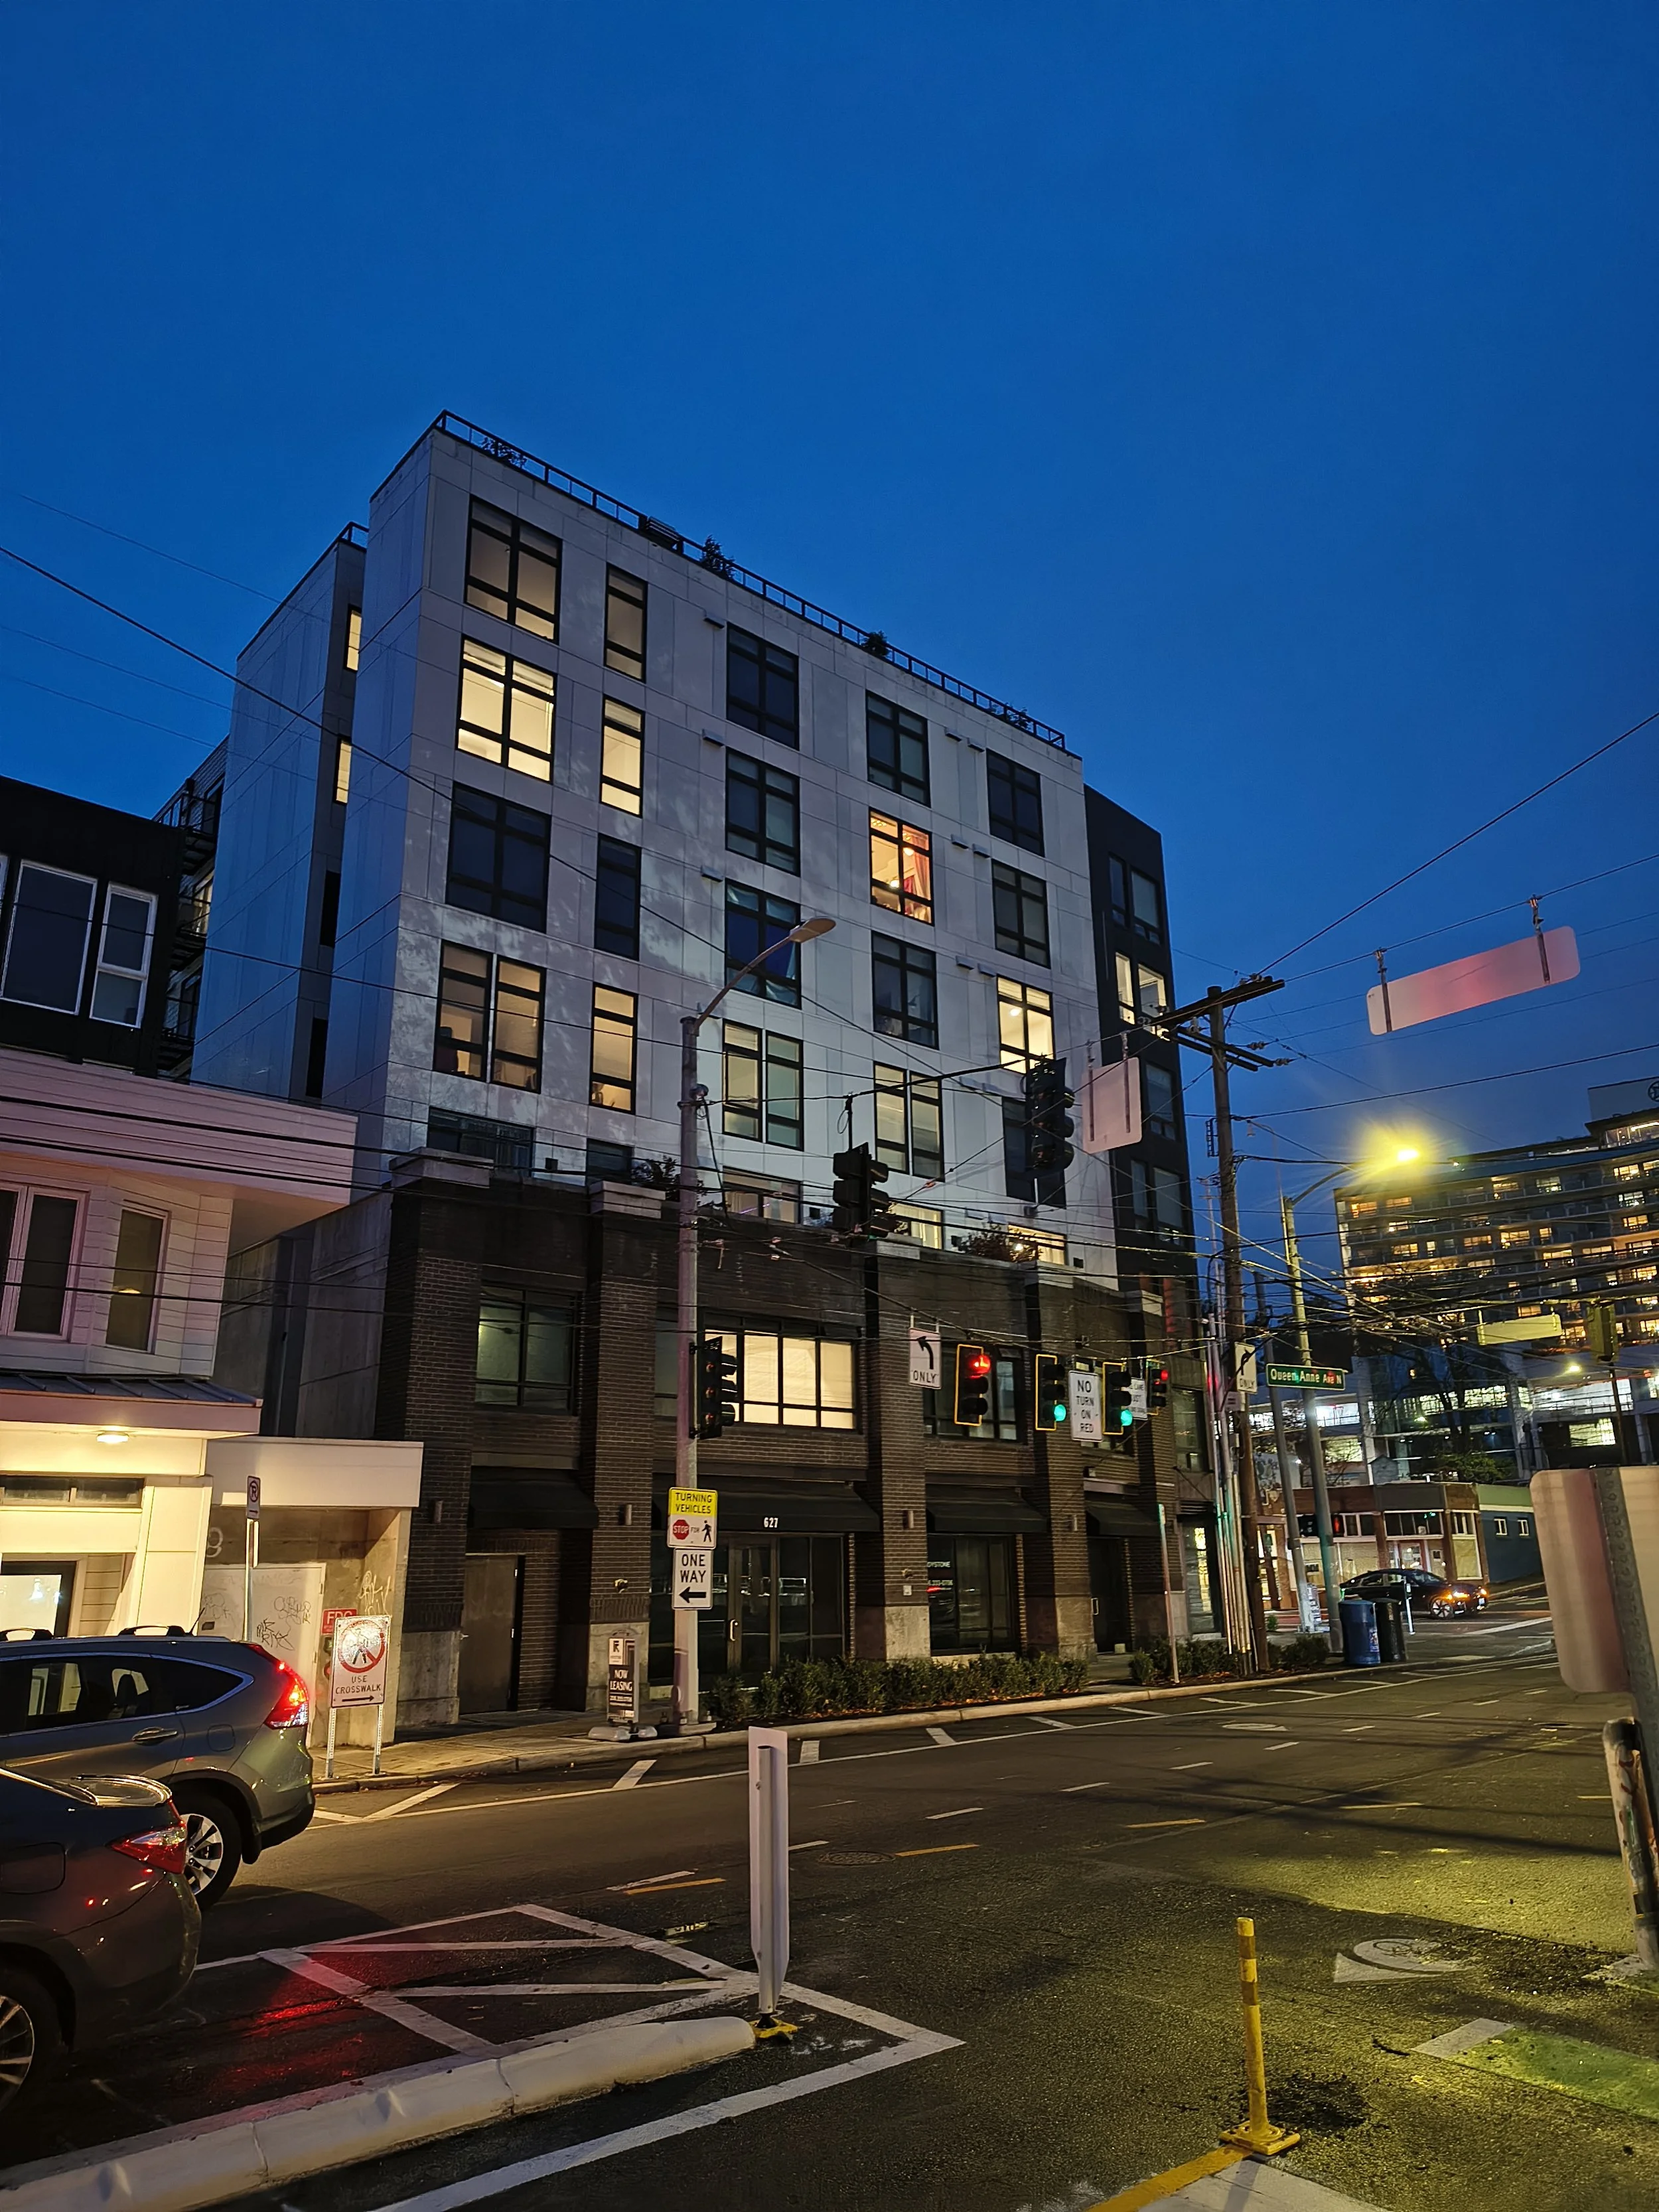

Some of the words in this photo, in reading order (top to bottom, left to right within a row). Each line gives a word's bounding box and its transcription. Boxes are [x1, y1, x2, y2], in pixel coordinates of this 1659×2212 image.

[913, 1370, 936, 1383] ONLY
[1270, 1368, 1299, 1381] Queen
[1300, 1370, 1320, 1382] Anne
[1323, 1374, 1334, 1384] Ave
[1336, 1374, 1342, 1384] N
[1077, 1380, 1092, 1393] NO
[1239, 1378, 1255, 1389] ONLY
[1076, 1395, 1094, 1406] TURN
[1080, 1409, 1091, 1420] ON
[1080, 1422, 1094, 1433] RED
[676, 1492, 712, 1503] TURNING
[676, 1503, 712, 1514] VEHICLES
[763, 1516, 779, 1528] 627
[673, 1525, 689, 1534] STOP
[682, 1554, 706, 1567] ONE
[680, 1570, 707, 1584] WAY
[351, 1675, 367, 1684] USE
[614, 1669, 628, 1679] NOW
[335, 1684, 382, 1694] CROSSWALK
[610, 1680, 632, 1692] LEASING
